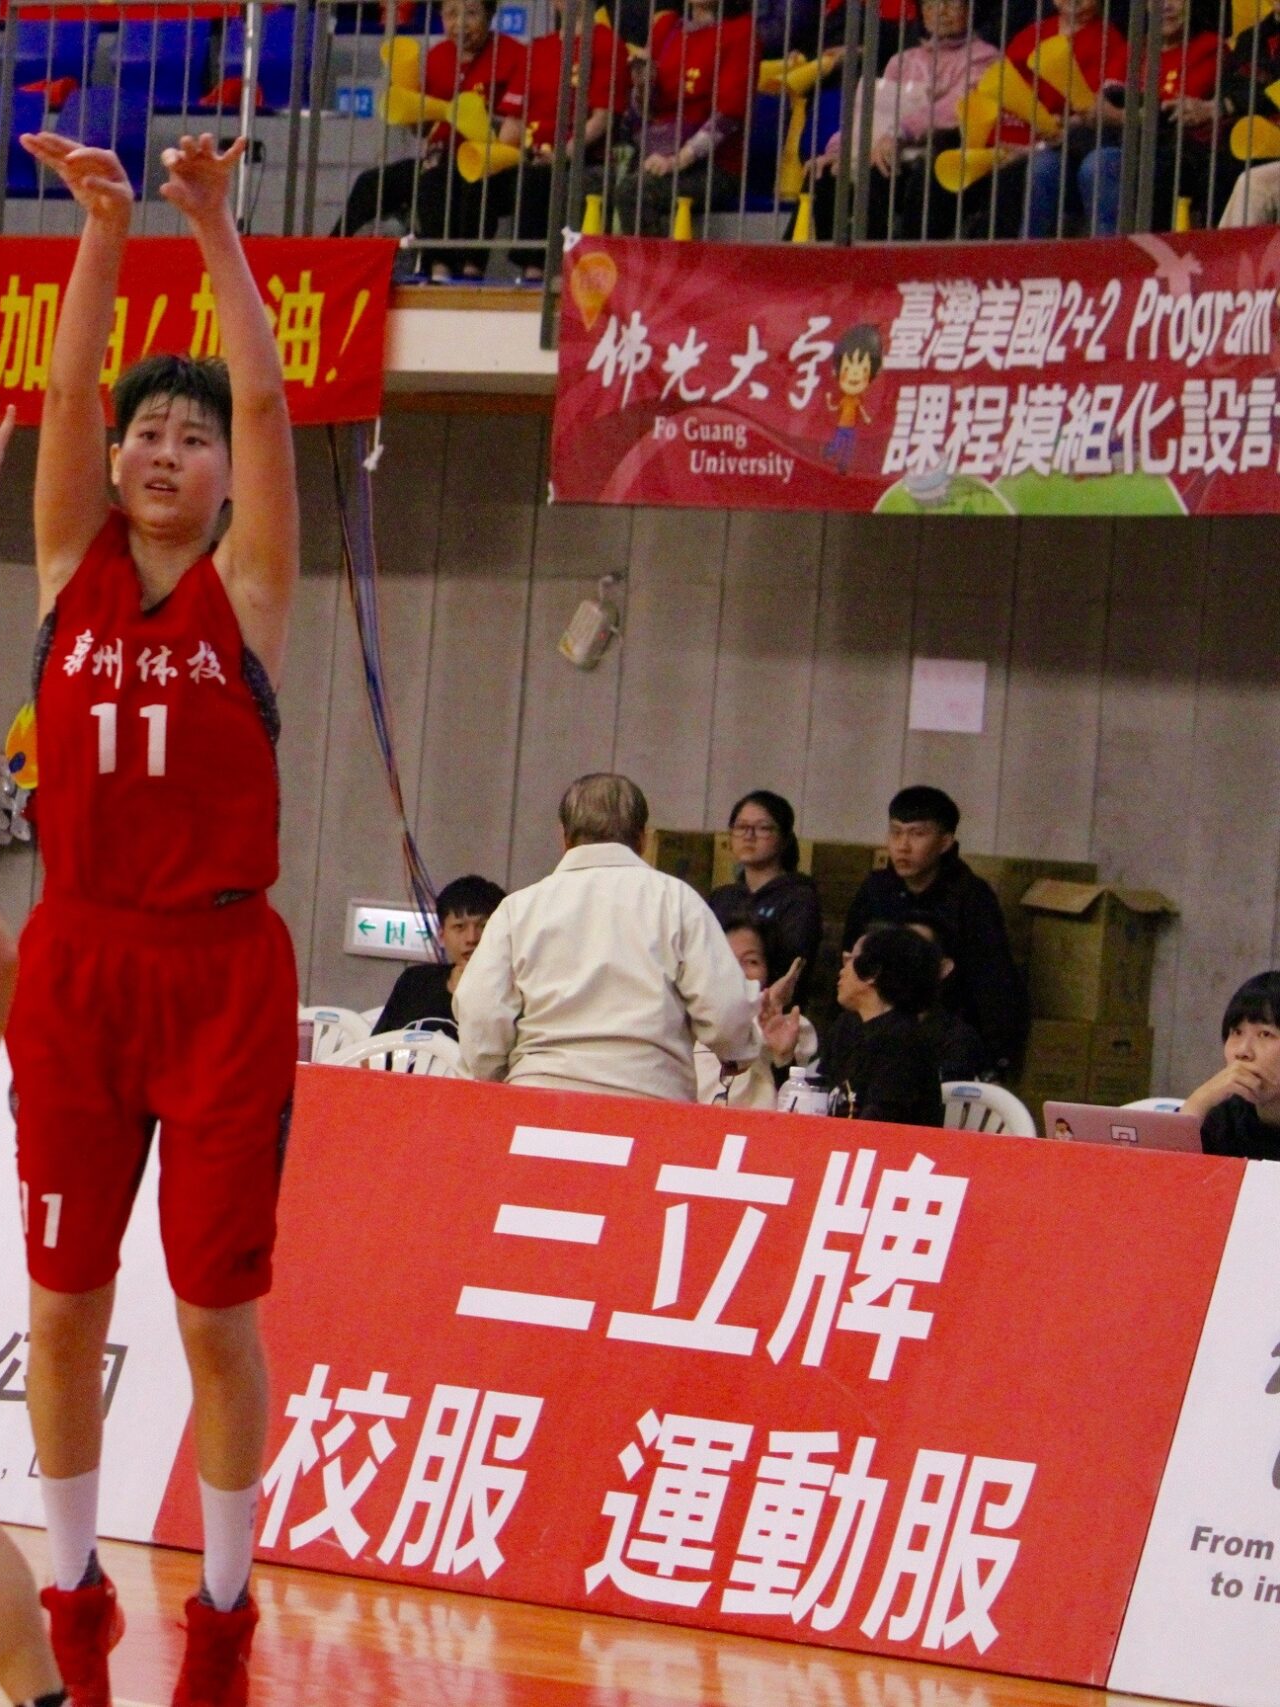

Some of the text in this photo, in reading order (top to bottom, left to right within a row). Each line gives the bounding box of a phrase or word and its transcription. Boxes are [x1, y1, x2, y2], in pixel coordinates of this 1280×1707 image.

[1126, 277, 1277, 368] Program
[652, 415, 747, 449] Fo Guang
[689, 450, 795, 482] University
[90, 702, 168, 777] 11
[455, 1124, 970, 1381] 三立牌
[260, 1363, 545, 1581] 校服
[583, 1407, 1038, 1656] 運動服
[1189, 1525, 1275, 1561] From
[1210, 1571, 1244, 1599] to
